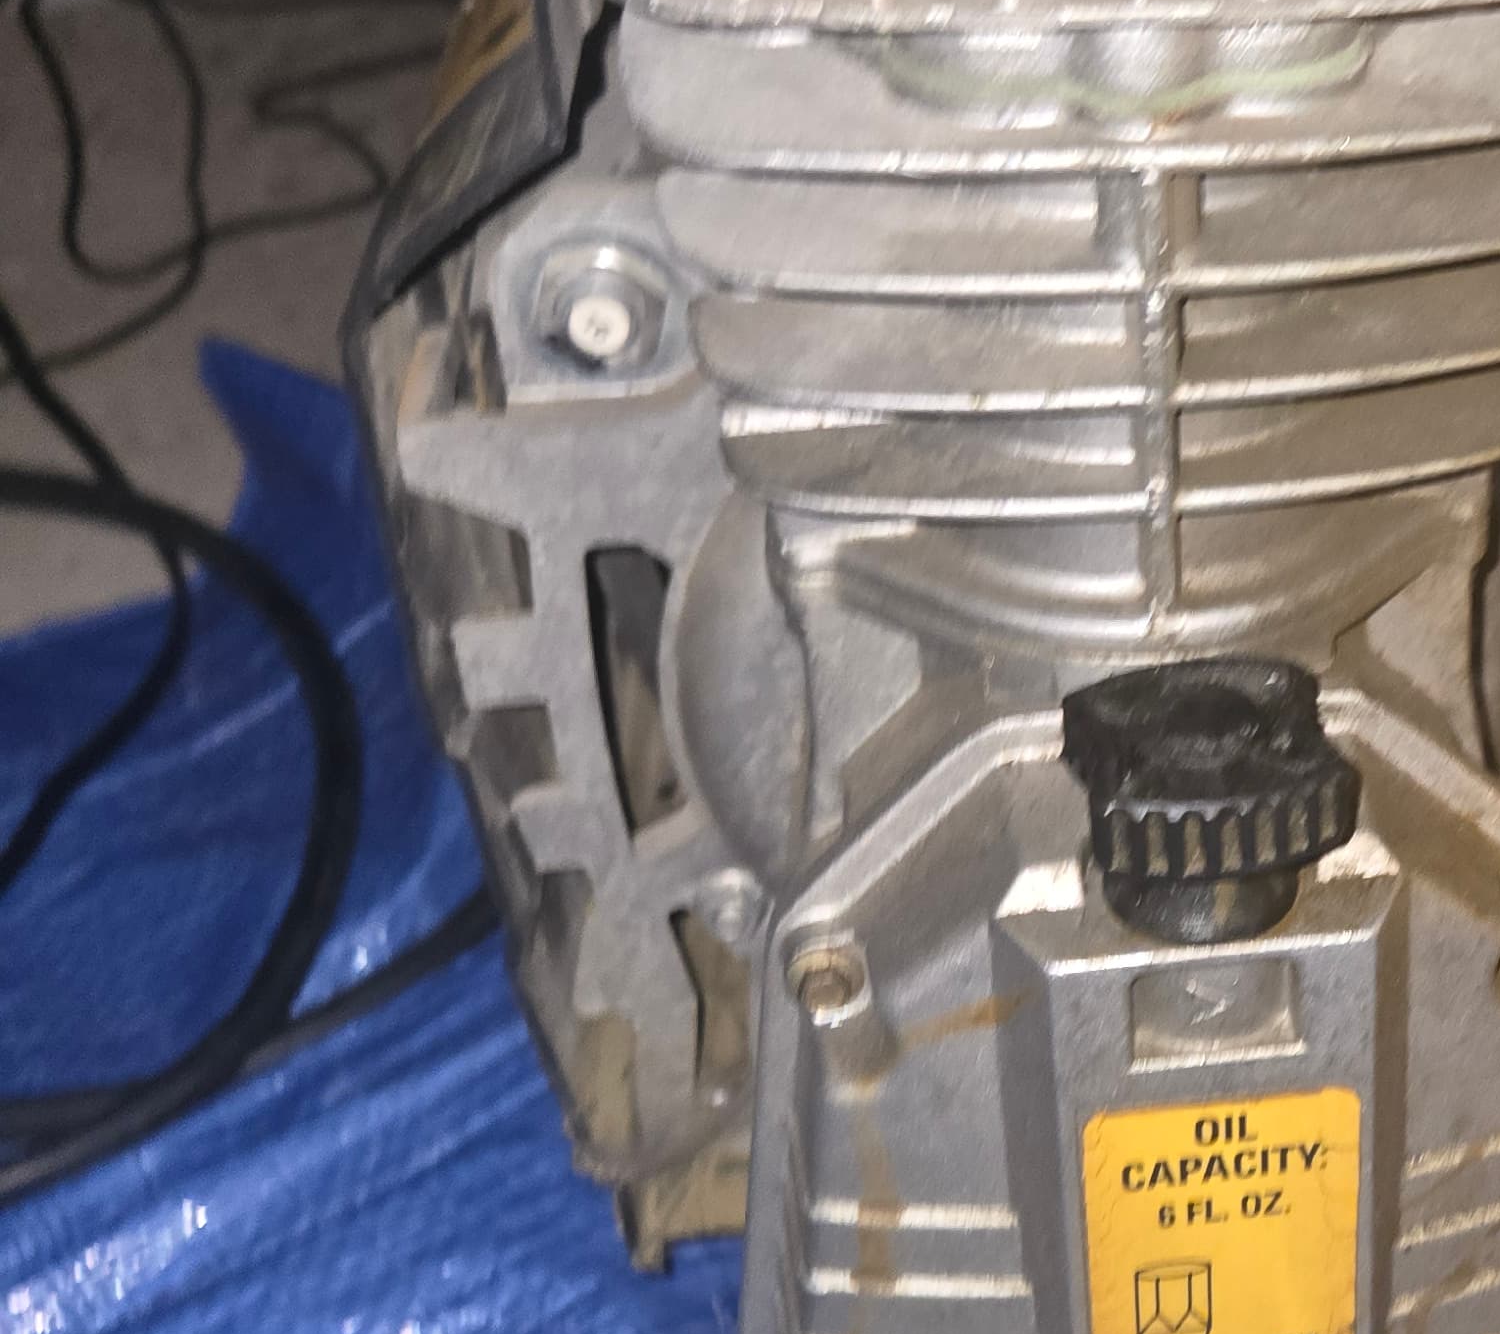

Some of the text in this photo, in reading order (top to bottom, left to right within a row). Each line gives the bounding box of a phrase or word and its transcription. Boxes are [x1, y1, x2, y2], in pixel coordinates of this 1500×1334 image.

[1194, 1111, 1258, 1147] OIL
[1121, 1140, 1329, 1193] CAPACITY:
[1158, 1187, 1292, 1229] 6 FL. OZ.
